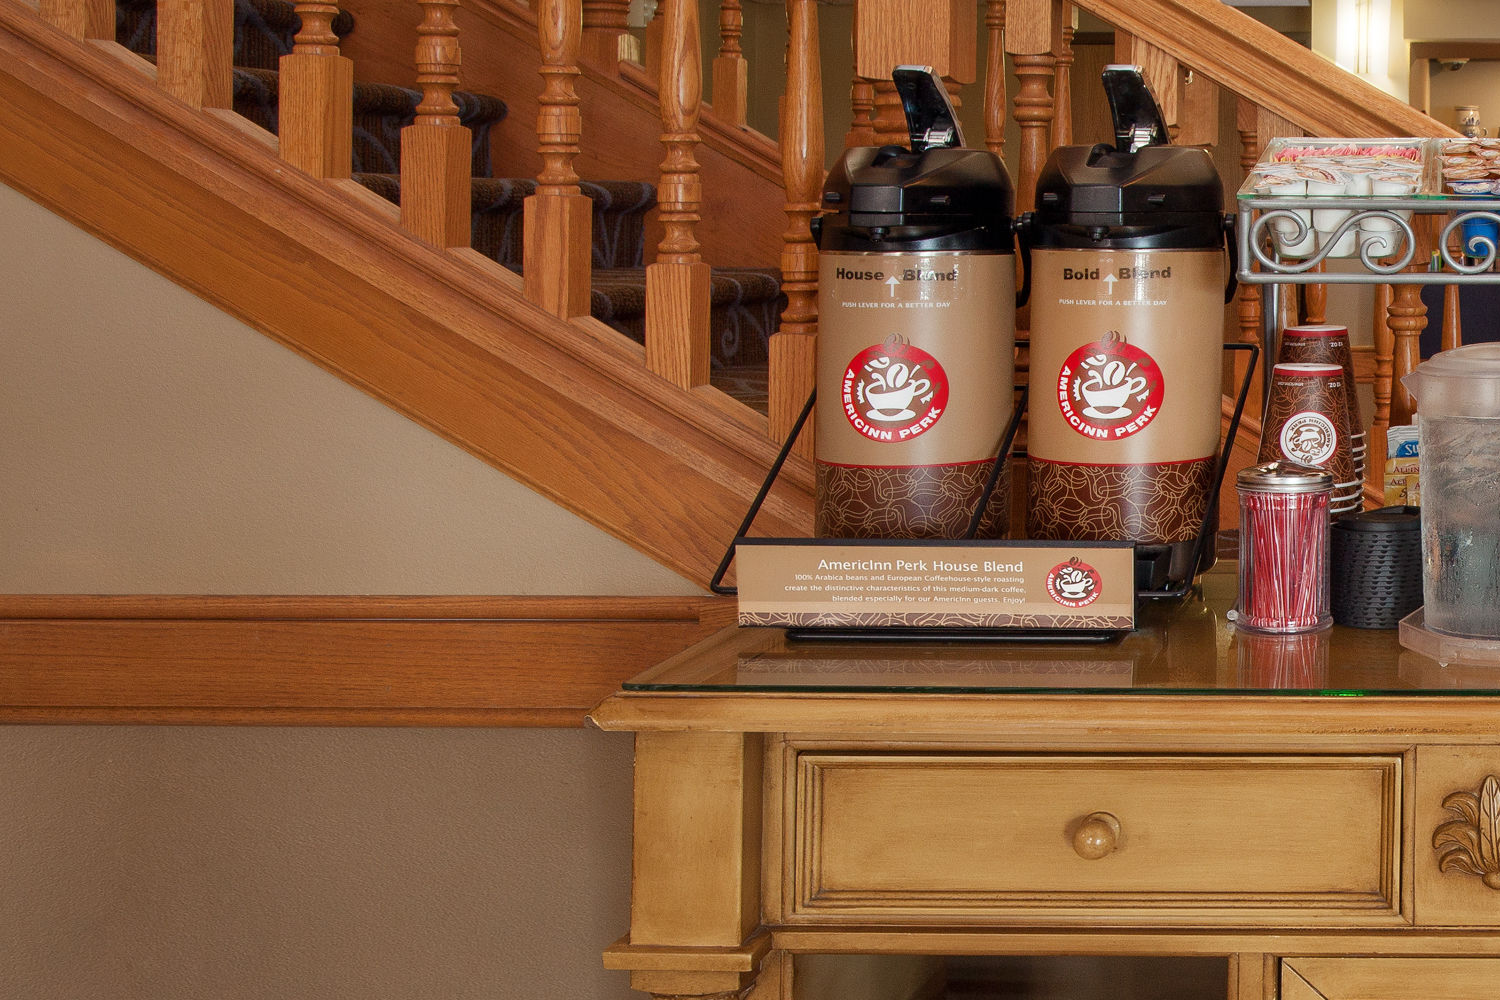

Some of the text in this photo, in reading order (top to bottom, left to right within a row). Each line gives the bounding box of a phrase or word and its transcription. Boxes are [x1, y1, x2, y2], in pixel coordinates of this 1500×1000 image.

[837, 268, 884, 280] House
[1064, 267, 1171, 280] Bold Blend
[843, 368, 942, 440] AMERICINN PERK
[1059, 365, 1157, 438] AMERICINN PERK
[818, 559, 1023, 573] AmericInn Perk House Blend
[925, 575, 991, 584] Coffeehouse-style
[994, 576, 1024, 584] roasting
[950, 586, 999, 594] medium-dark
[1001, 586, 1026, 594] coffee,
[1047, 573, 1099, 607] AMERICINN PERK
[865, 595, 902, 603] especially
